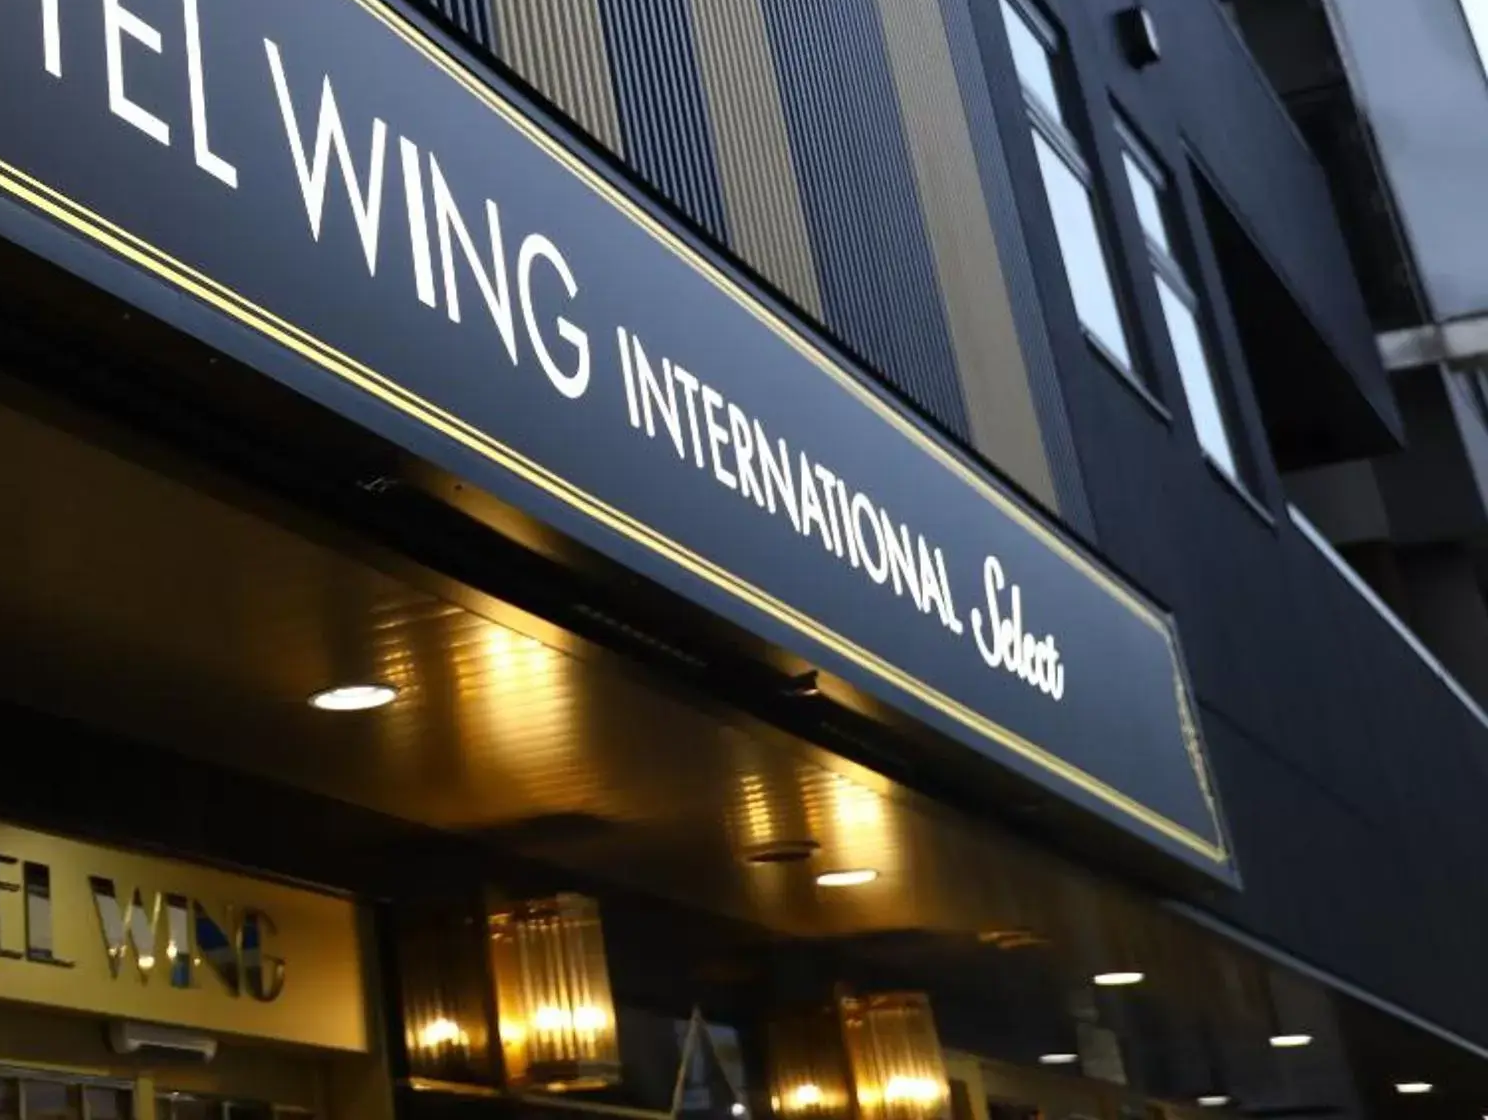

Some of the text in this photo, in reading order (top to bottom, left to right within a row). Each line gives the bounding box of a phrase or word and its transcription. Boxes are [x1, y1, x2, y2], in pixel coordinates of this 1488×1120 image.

[264, 38, 590, 399] WING
[617, 326, 964, 635] INTERNATIONAL
[971, 556, 1064, 700] Select
[88, 875, 286, 1003] WING
